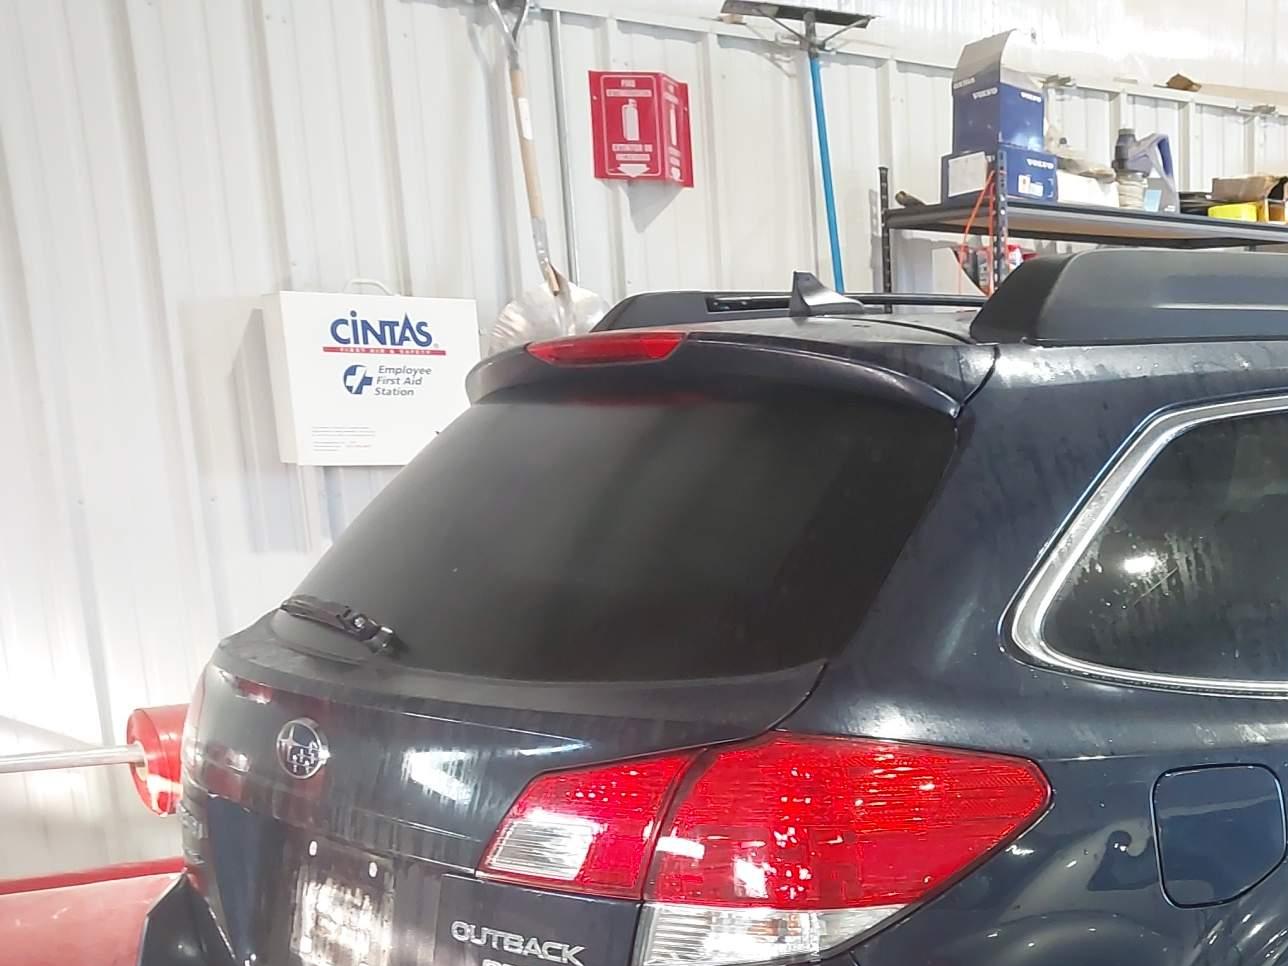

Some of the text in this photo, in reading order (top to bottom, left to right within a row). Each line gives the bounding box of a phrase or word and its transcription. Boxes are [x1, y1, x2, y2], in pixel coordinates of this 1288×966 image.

[379, 365, 432, 377] Employee
[376, 376, 423, 385] First Aid
[374, 387, 415, 396] Station
